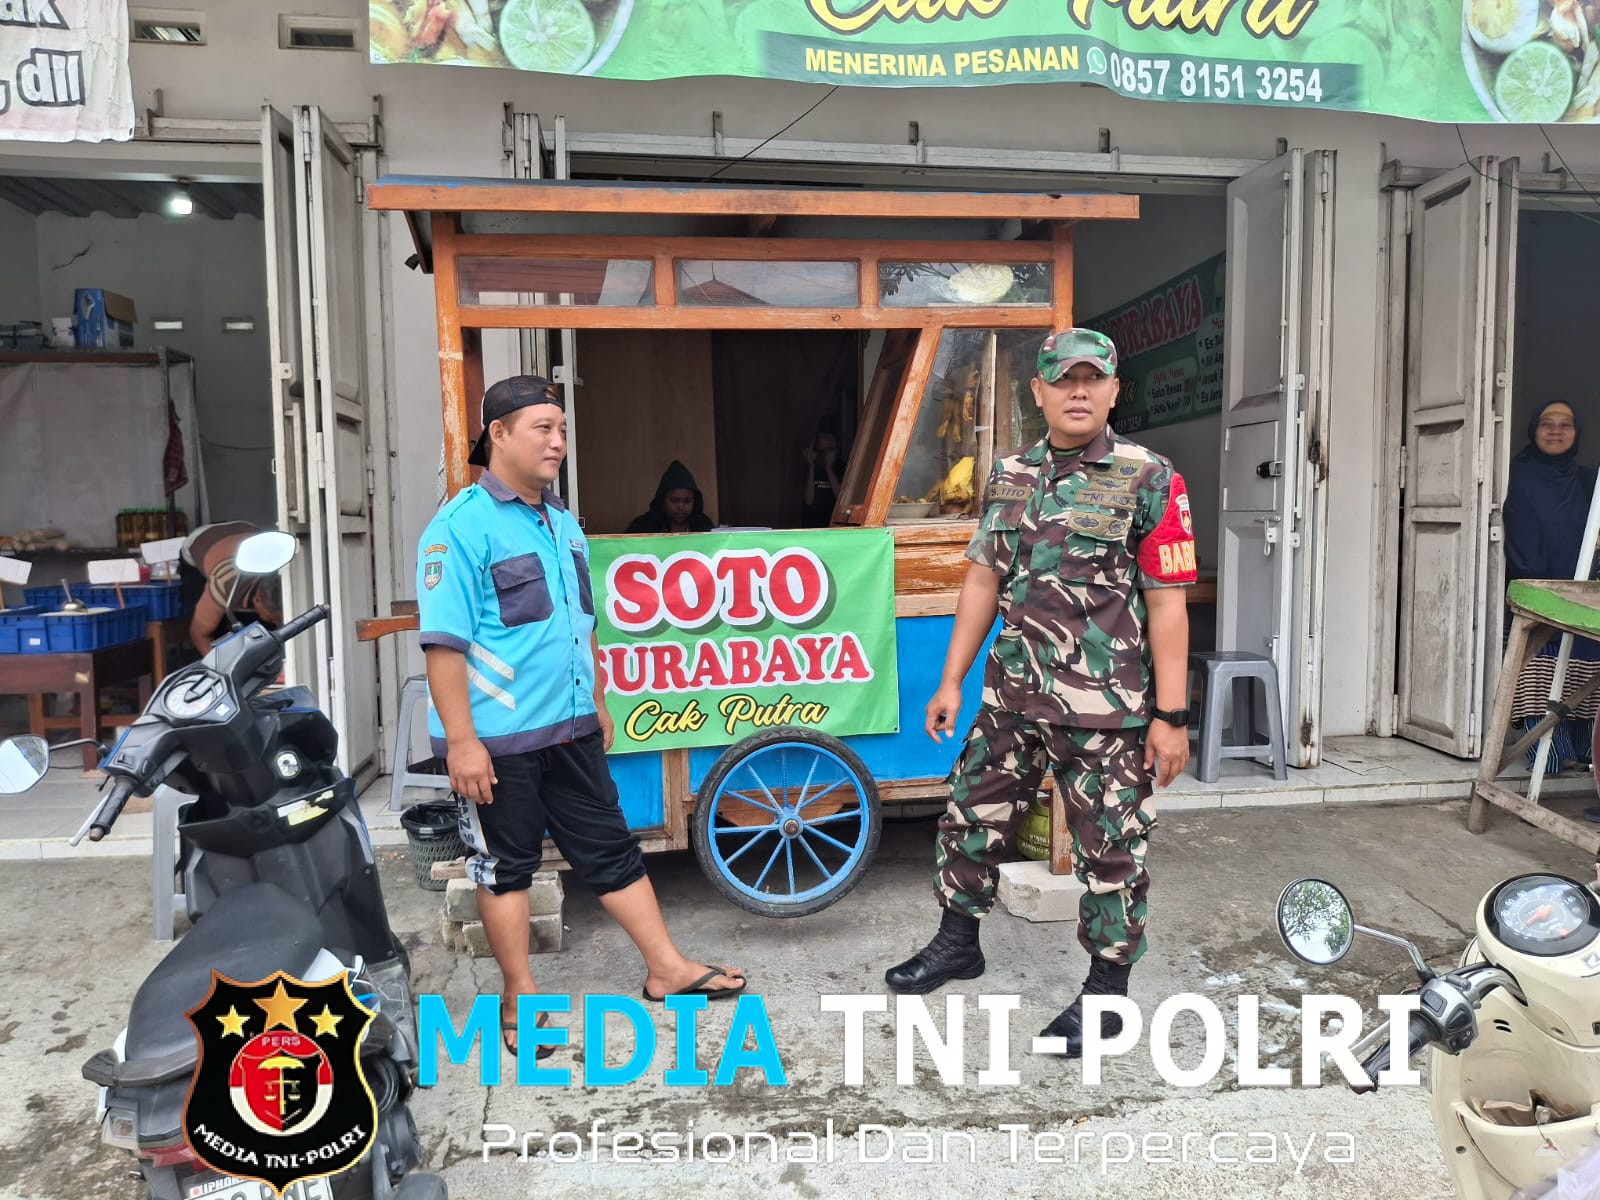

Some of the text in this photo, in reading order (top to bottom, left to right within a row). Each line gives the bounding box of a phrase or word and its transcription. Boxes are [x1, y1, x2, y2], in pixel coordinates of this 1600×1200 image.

[16, 47, 86, 107] dll
[805, 46, 1323, 102] MENERIMA PESANAN 0857 8151 3254
[1098, 274, 1203, 361] URABAYA
[607, 548, 828, 631] SOTO
[625, 693, 828, 742] Cak Putra
